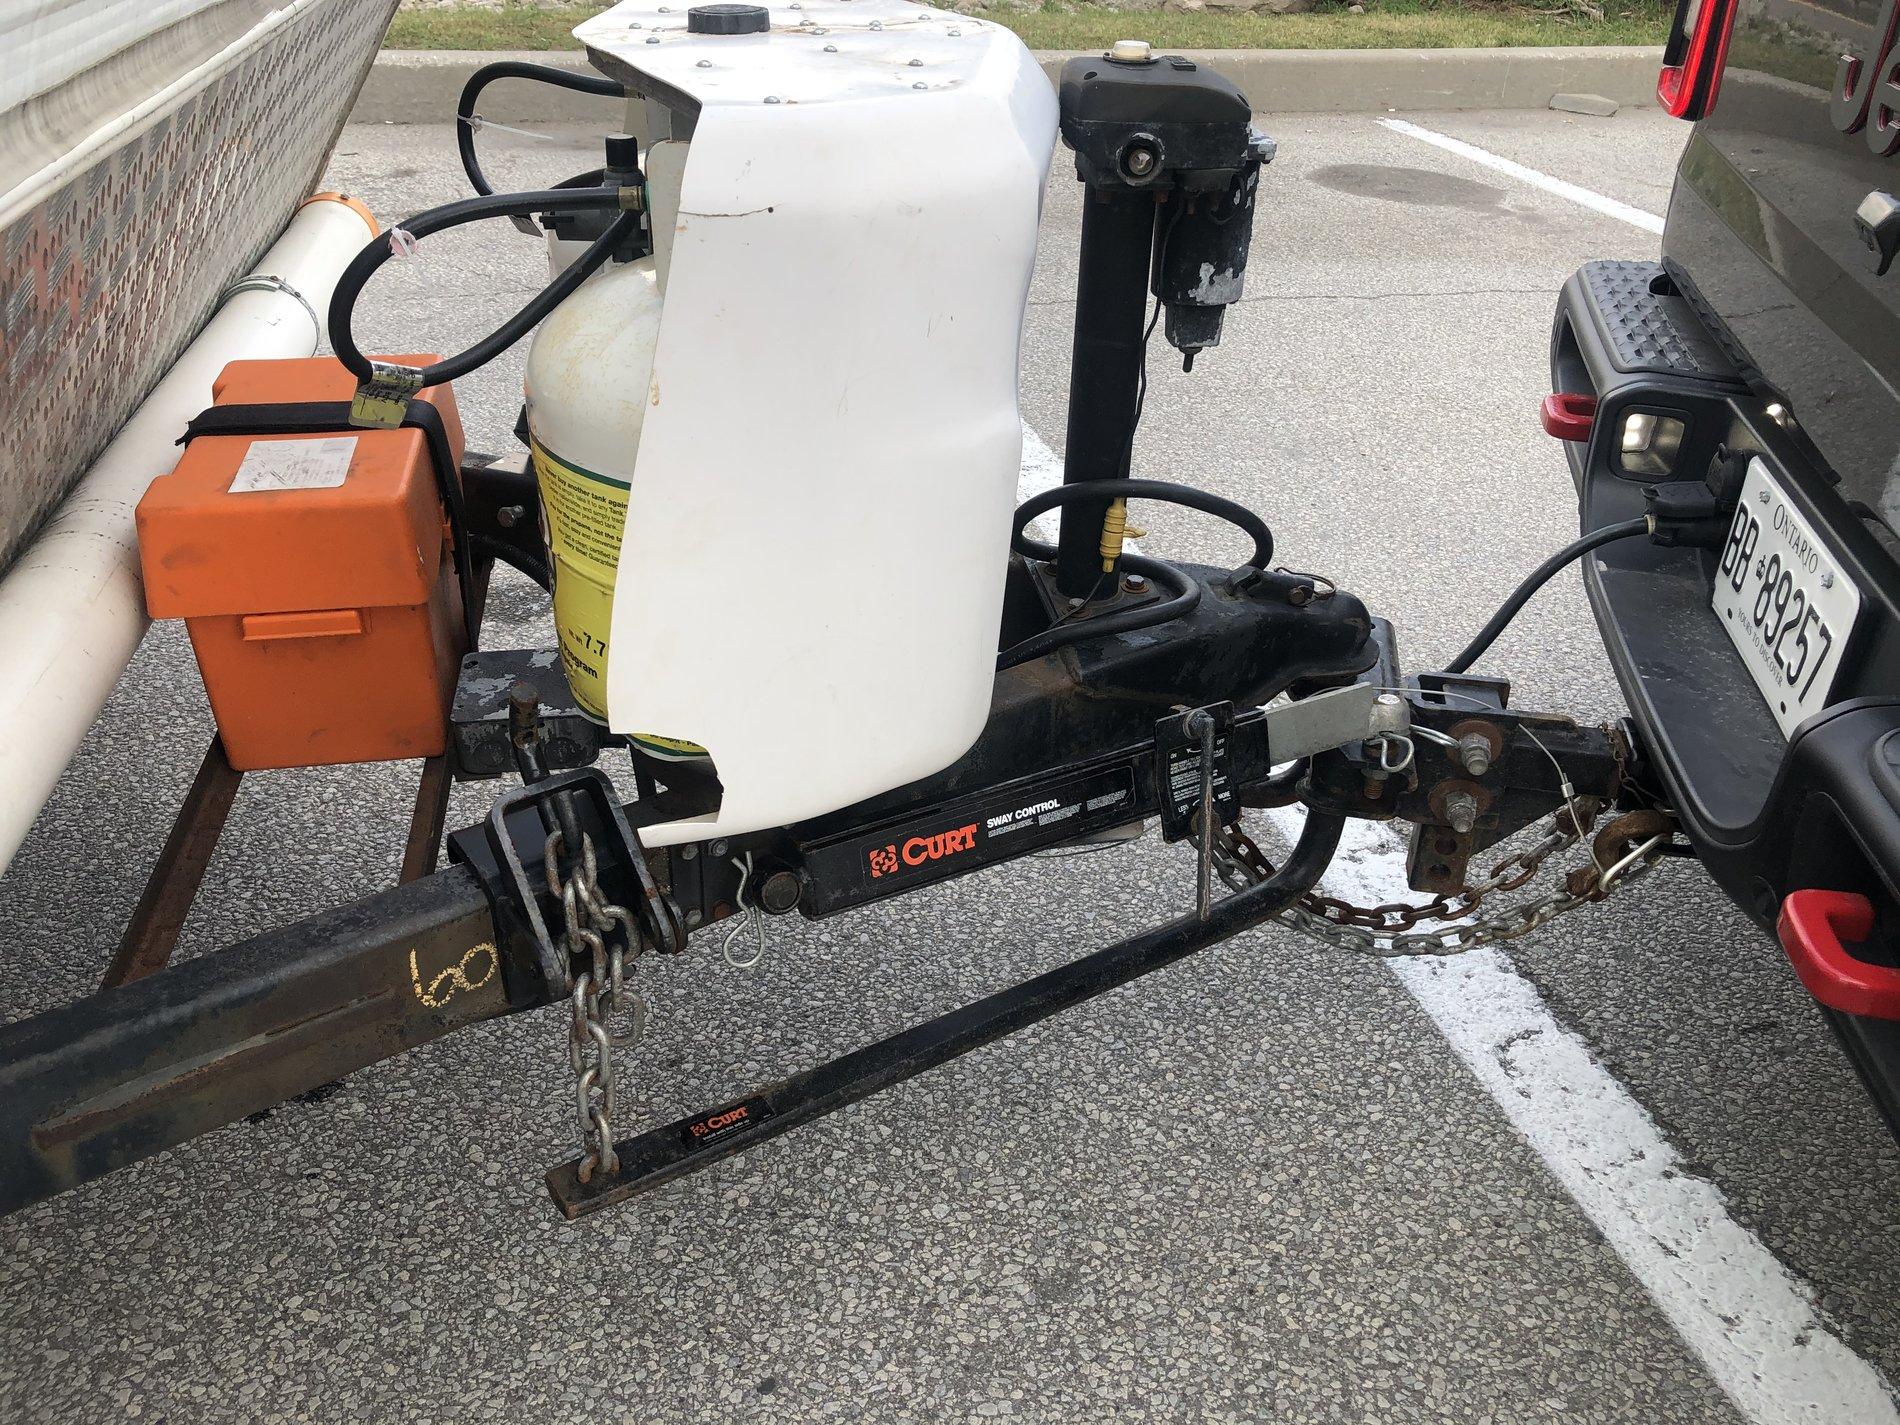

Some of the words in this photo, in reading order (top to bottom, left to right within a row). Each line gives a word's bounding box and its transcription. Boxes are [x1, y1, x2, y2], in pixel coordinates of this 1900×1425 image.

[557, 476, 566, 486] buy
[567, 483, 590, 497] another
[591, 492, 606, 504] tank
[608, 499, 628, 509] again
[593, 509, 610, 521] simply
[593, 528, 604, 537] not
[604, 531, 614, 541] the
[1773, 504, 1819, 574] ONTARIO
[589, 546, 610, 559] certified
[1721, 501, 1760, 593] BB
[1753, 553, 1832, 704] 89257
[1738, 608, 1753, 636] YOURS
[1759, 644, 1783, 688] DISCOVER
[1218, 791, 1231, 800] MORE
[986, 812, 1014, 829] SWAY
[1015, 799, 1061, 820] CONTROL
[902, 823, 978, 866] CURT
[707, 1106, 748, 1129] CURT
